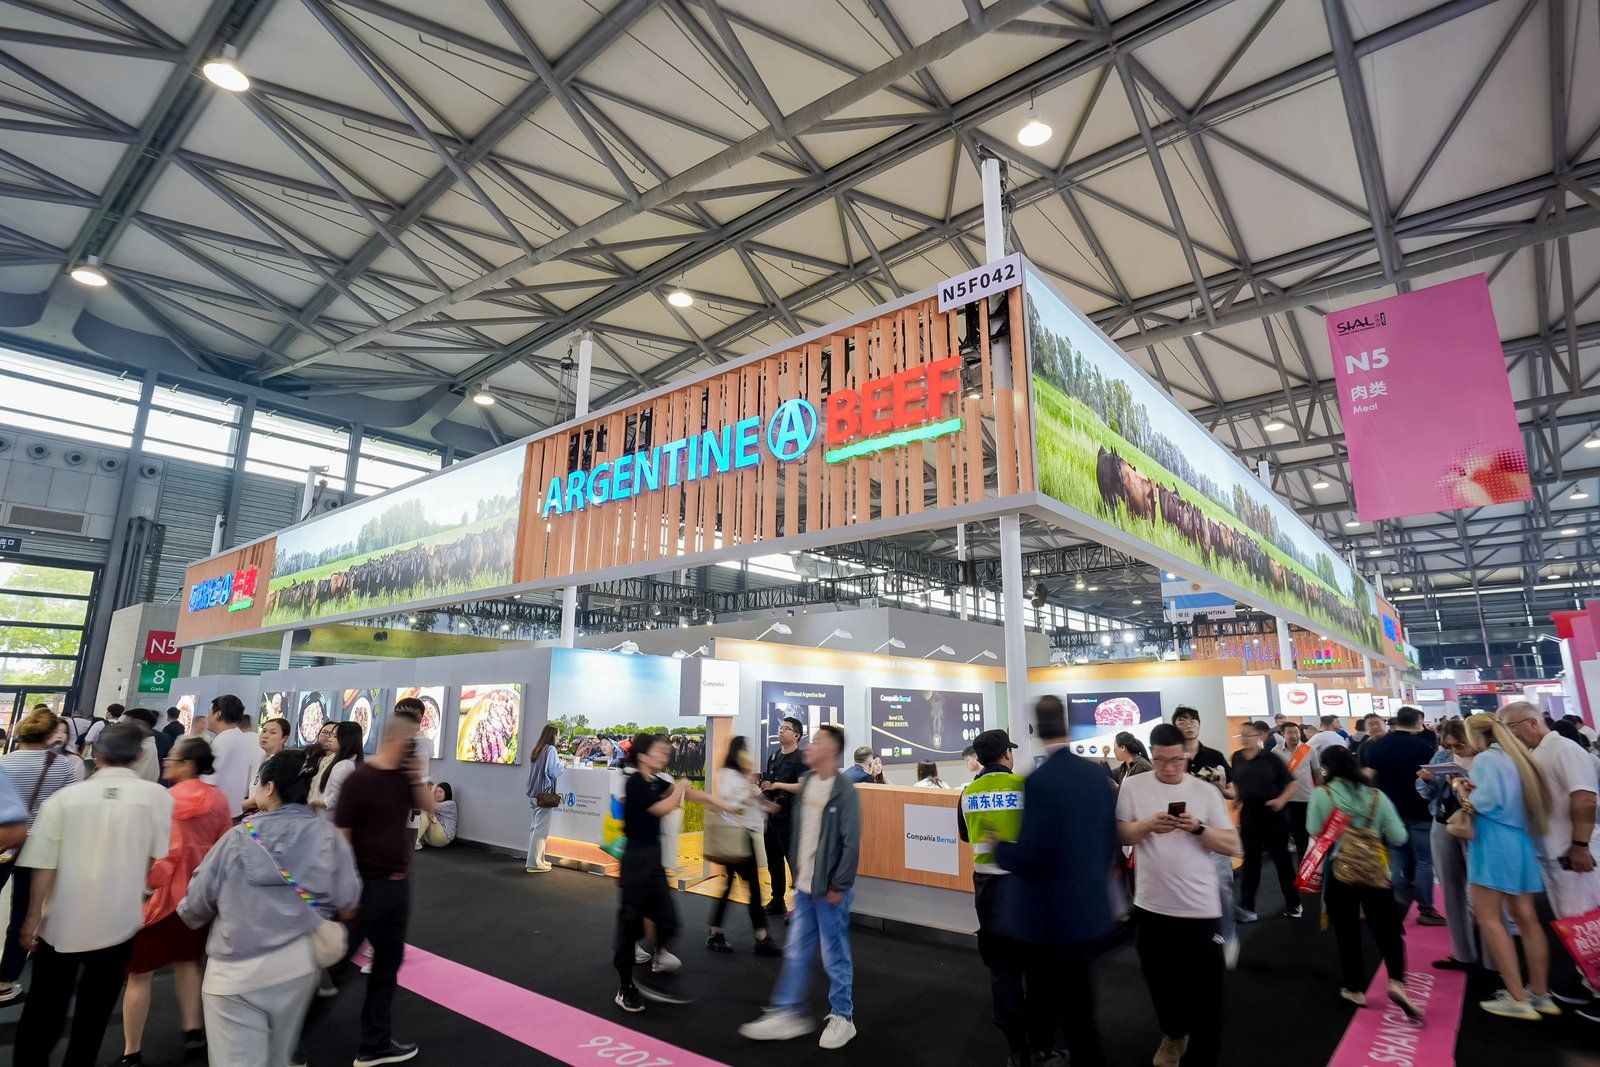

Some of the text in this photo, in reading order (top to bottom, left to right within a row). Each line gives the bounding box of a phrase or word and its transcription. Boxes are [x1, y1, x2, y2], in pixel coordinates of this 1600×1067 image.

[943, 263, 1016, 303] N5F042
[1337, 316, 1375, 334] SIAL
[1345, 347, 1389, 374] N5
[1351, 380, 1388, 402] 肉类
[1353, 403, 1378, 414] Meat
[541, 415, 761, 519] ARGENTINE
[826, 355, 961, 445] BEEF
[150, 637, 177, 655] N5
[153, 669, 165, 685] 8
[967, 793, 1018, 810] 浦东保安
[906, 832, 957, 845] Compañía Bernal
